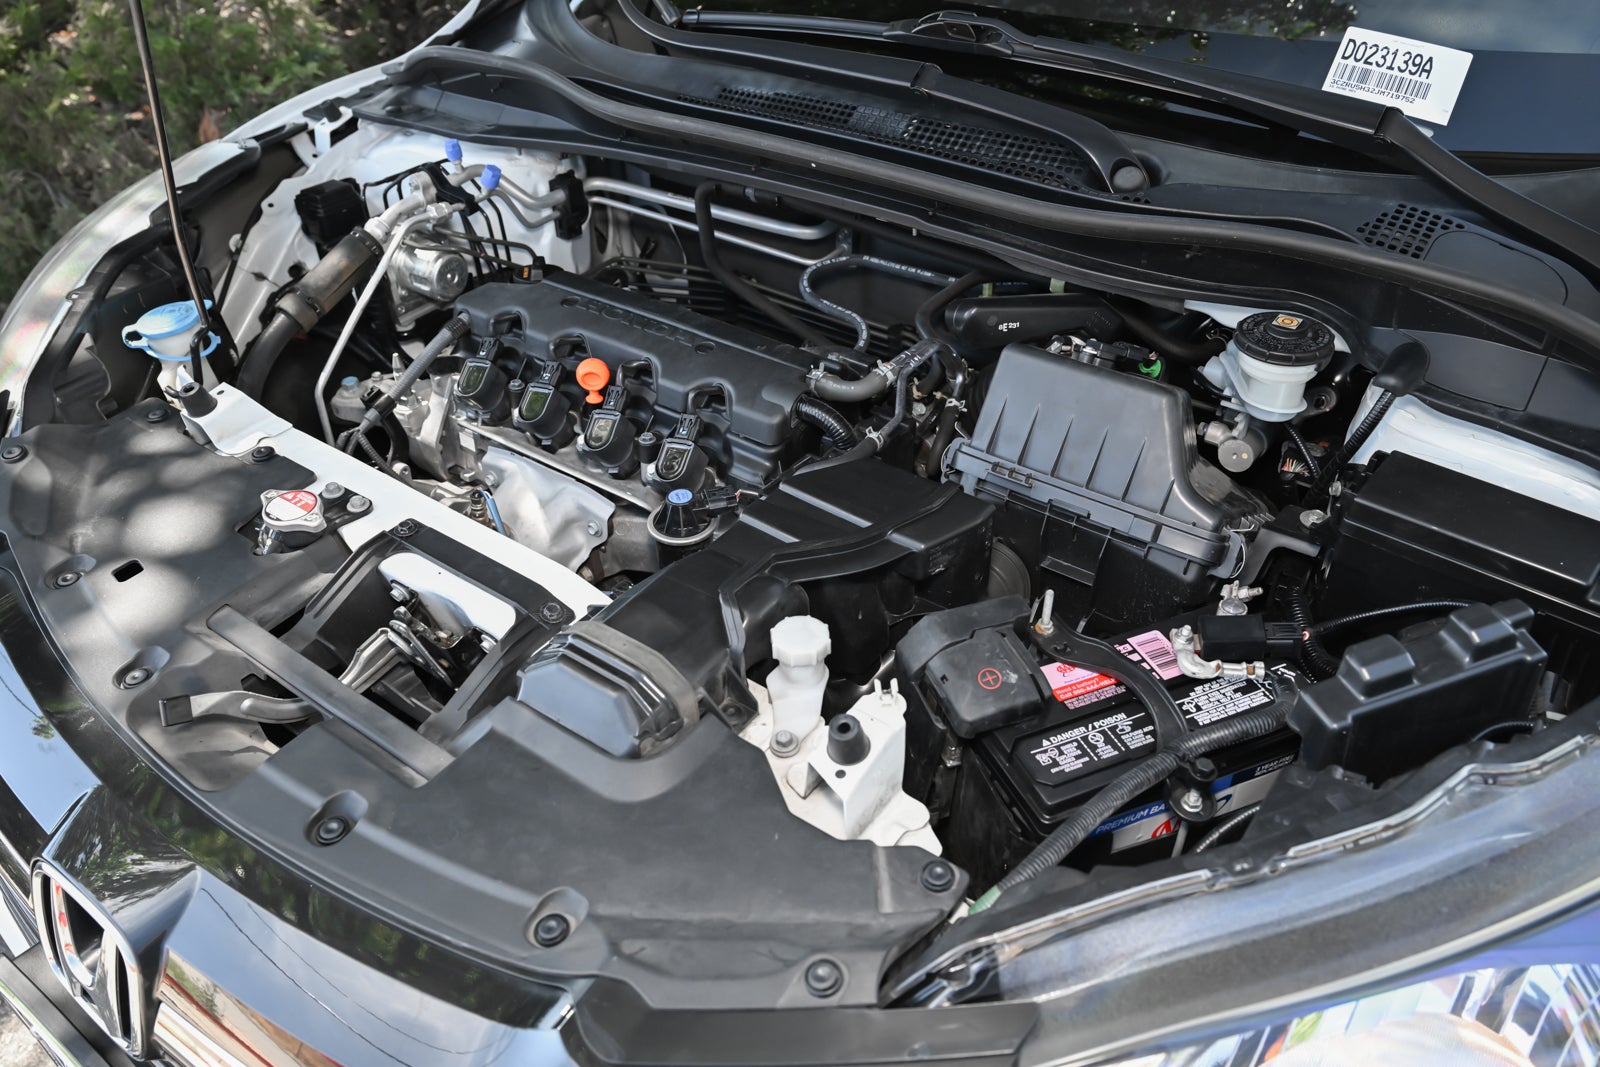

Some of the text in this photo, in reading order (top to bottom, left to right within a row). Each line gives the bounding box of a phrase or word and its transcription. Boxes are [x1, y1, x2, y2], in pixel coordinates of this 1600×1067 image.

[1341, 38, 1434, 79] D023139A
[1050, 726, 1087, 744] DANGER
[1093, 712, 1128, 729] POISON
[1096, 808, 1149, 834] PREMIUM
[1149, 803, 1167, 815] BA
